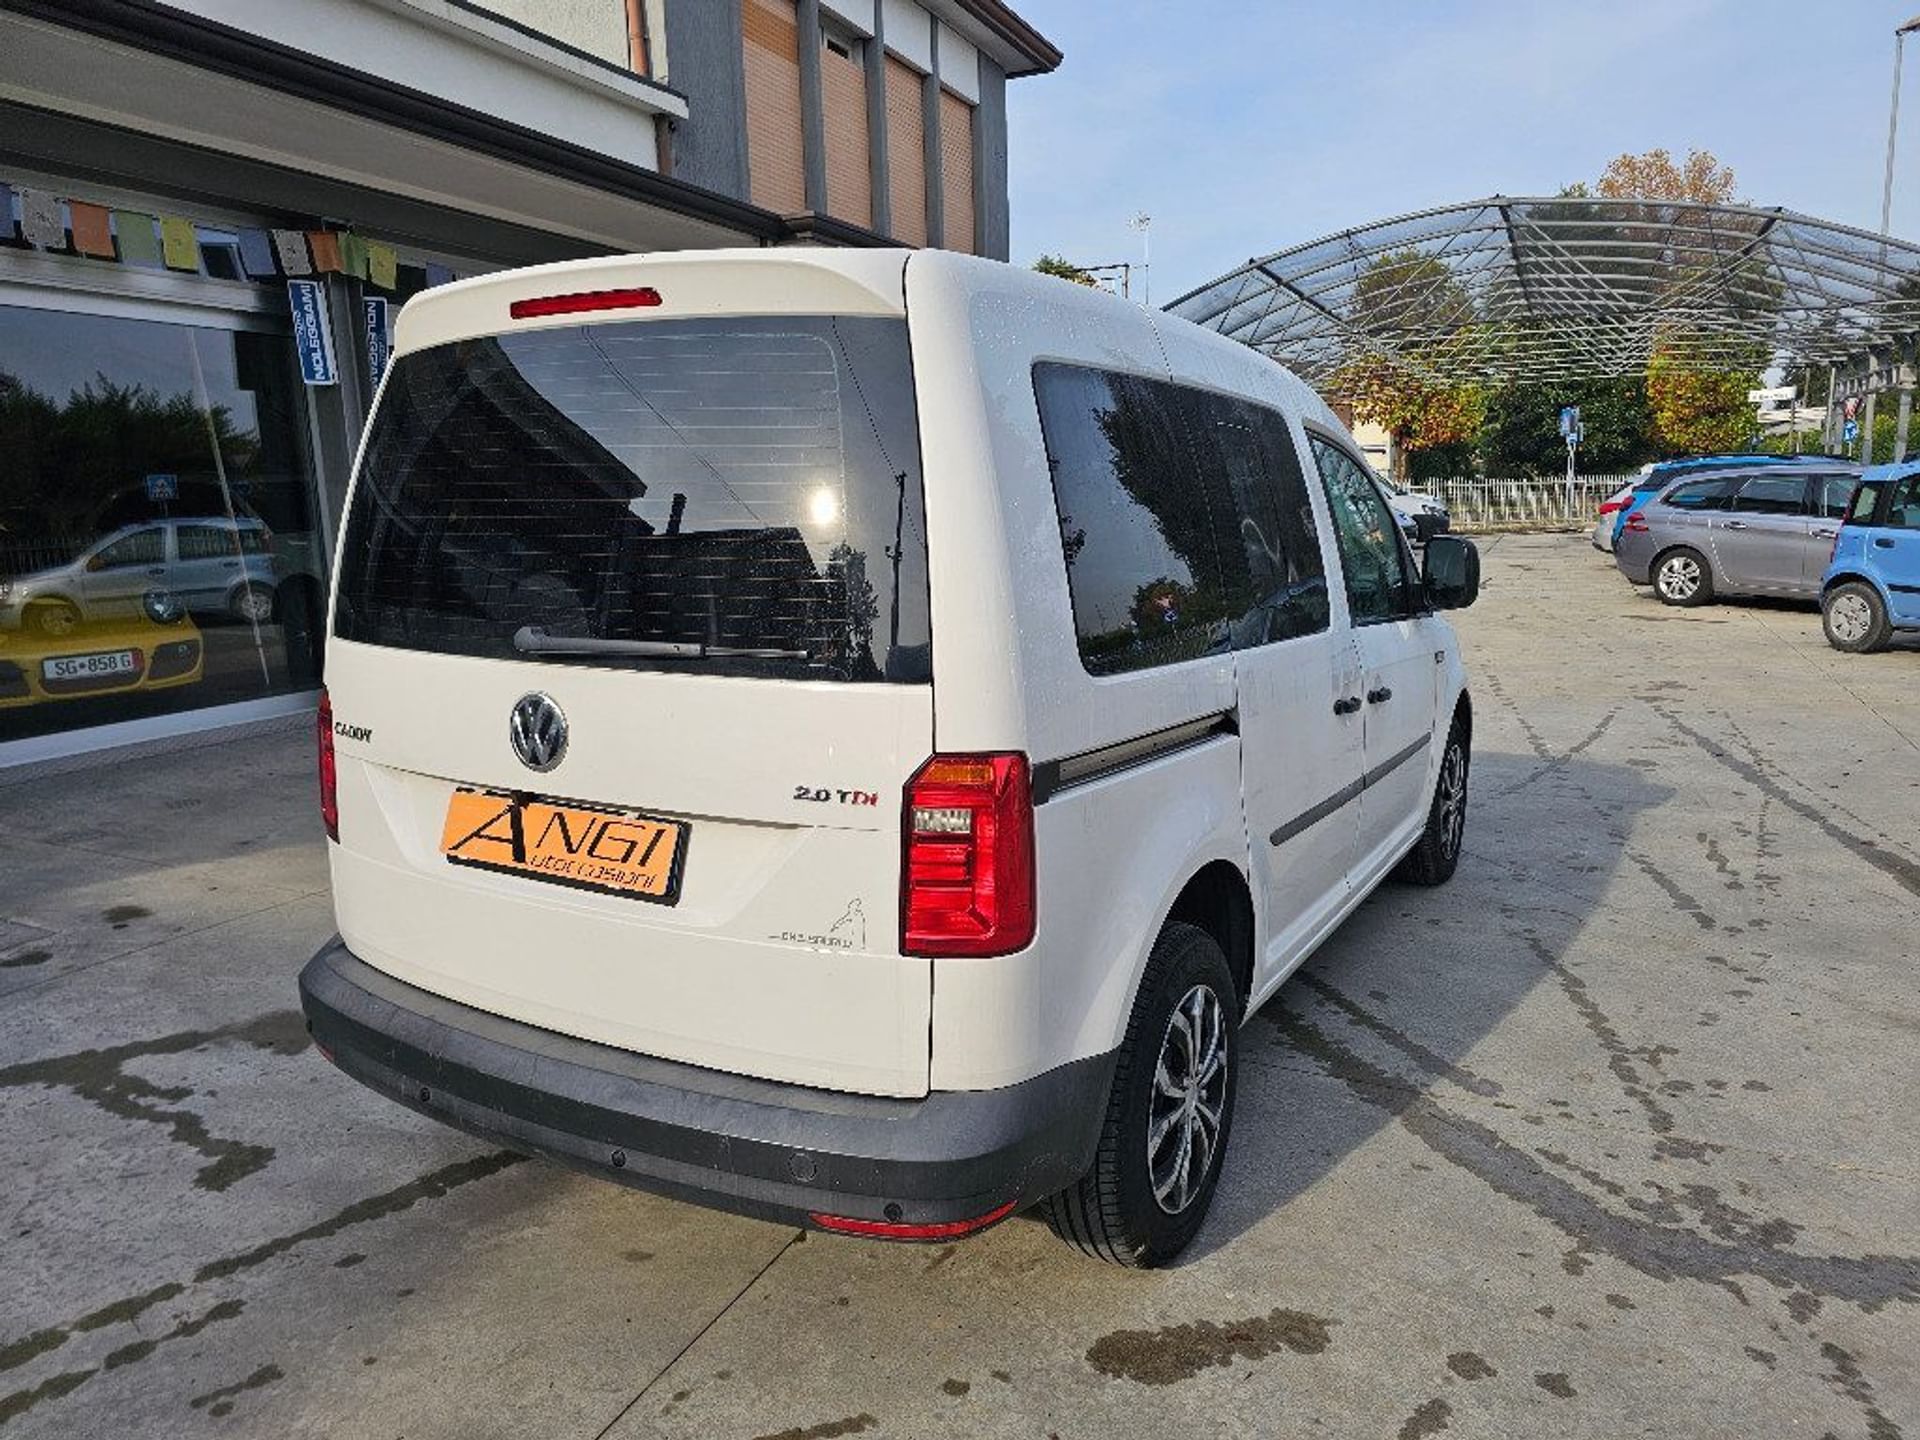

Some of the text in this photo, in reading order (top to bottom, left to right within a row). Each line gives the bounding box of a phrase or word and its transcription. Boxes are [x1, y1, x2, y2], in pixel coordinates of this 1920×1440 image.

[334, 720, 373, 744] CADDY
[836, 789, 878, 807] TDI
[448, 792, 667, 865] ANGI
